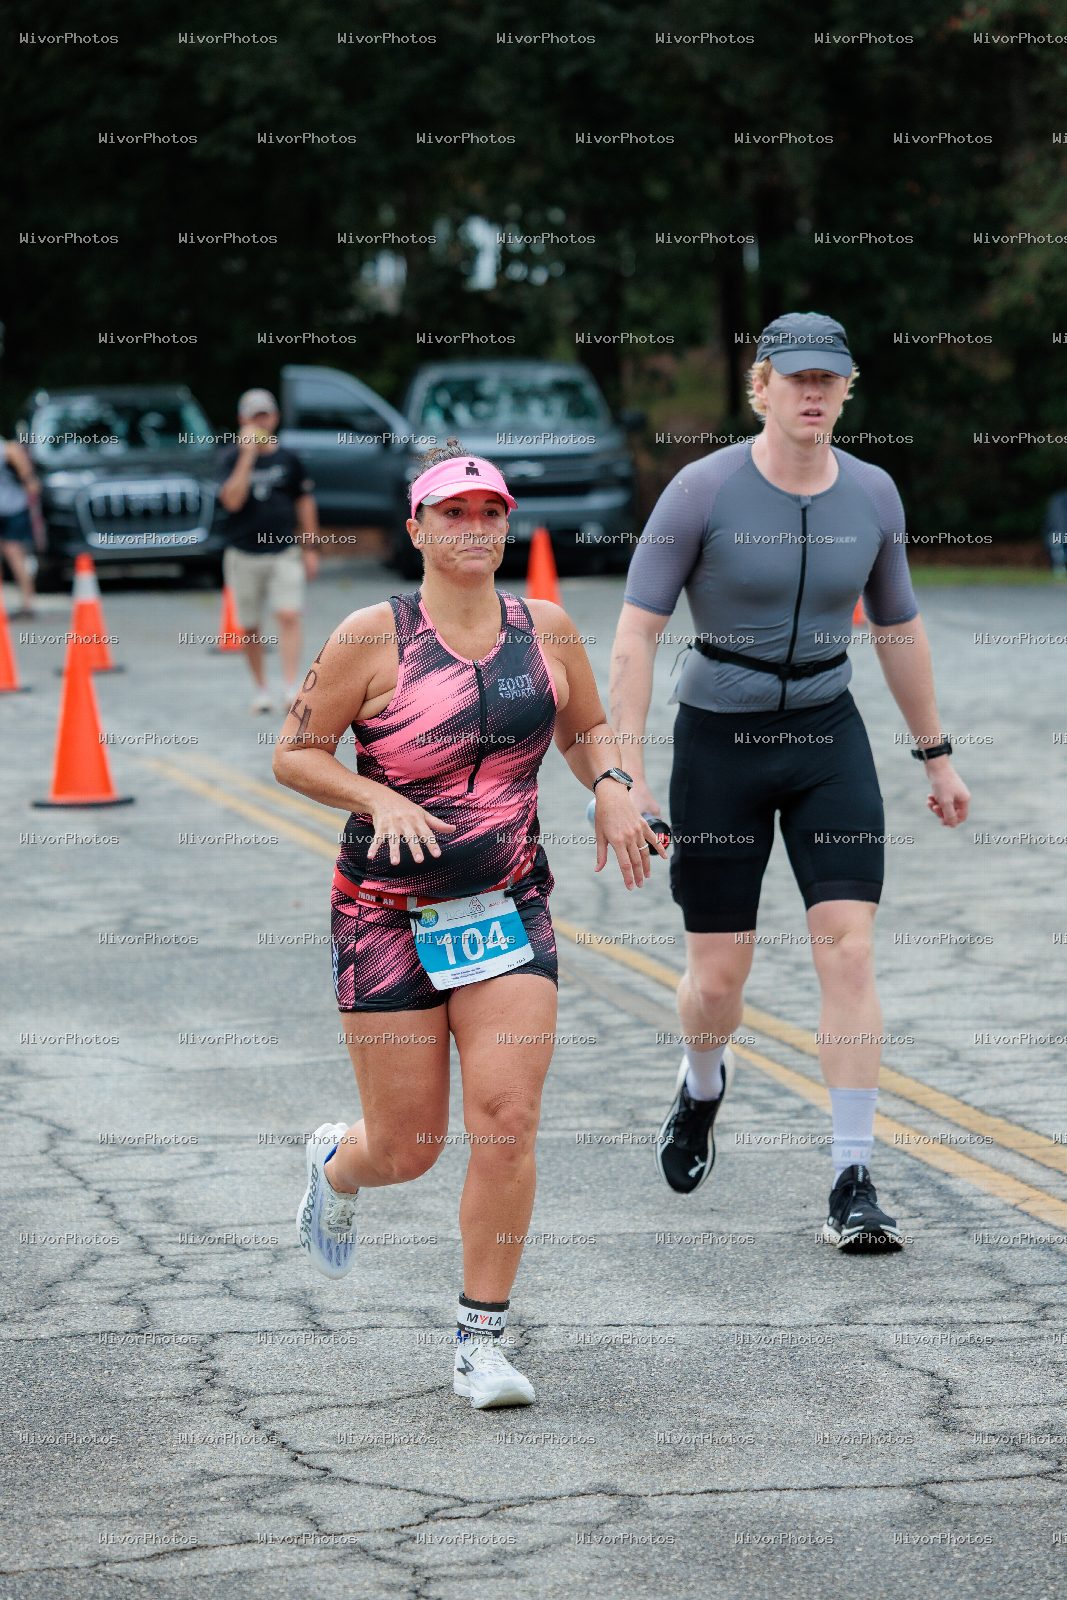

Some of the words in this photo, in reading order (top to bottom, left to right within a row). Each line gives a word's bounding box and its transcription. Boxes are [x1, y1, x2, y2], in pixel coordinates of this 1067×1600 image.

[831, 536, 857, 544] IXEN
[498, 674, 533, 691] ZOOT
[437, 920, 509, 966] 104
[467, 1312, 502, 1327] MYLA
